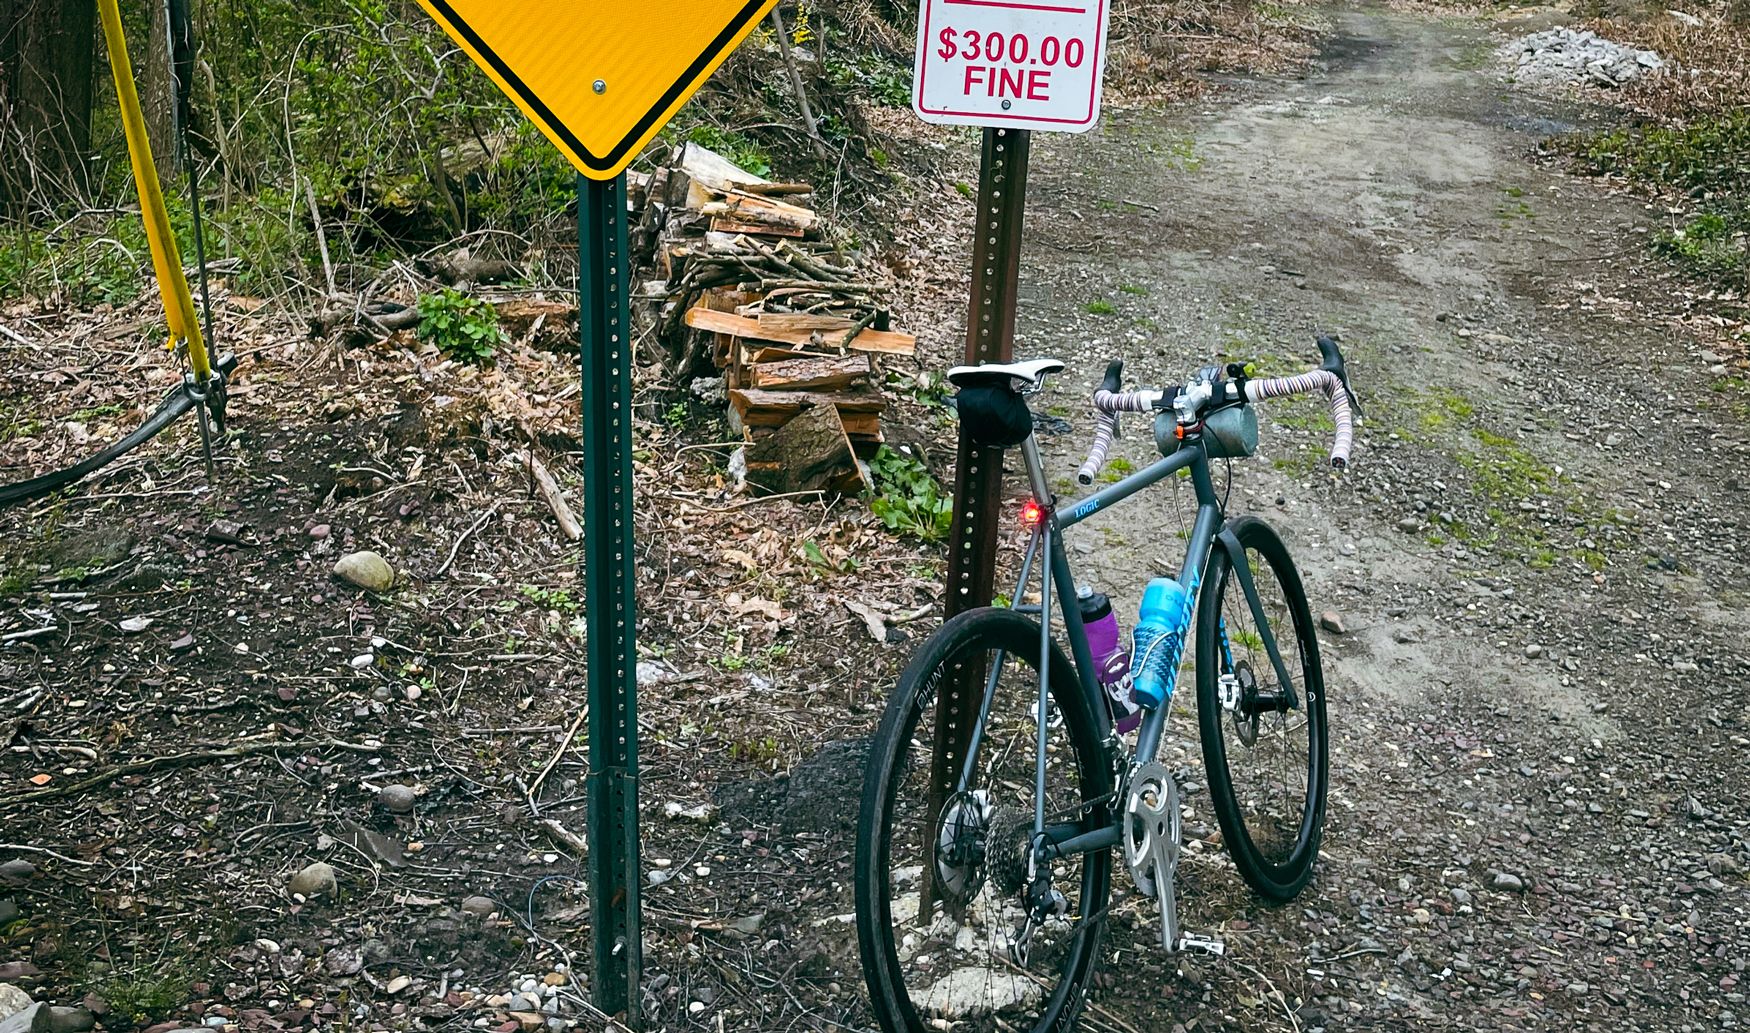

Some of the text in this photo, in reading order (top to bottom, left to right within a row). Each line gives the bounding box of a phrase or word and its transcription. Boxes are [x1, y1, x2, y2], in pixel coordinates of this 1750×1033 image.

[937, 26, 1085, 68] $300.00
[963, 65, 1052, 101] FINE
[1074, 498, 1100, 518] LOGIC
[922, 660, 946, 698] HUNT
